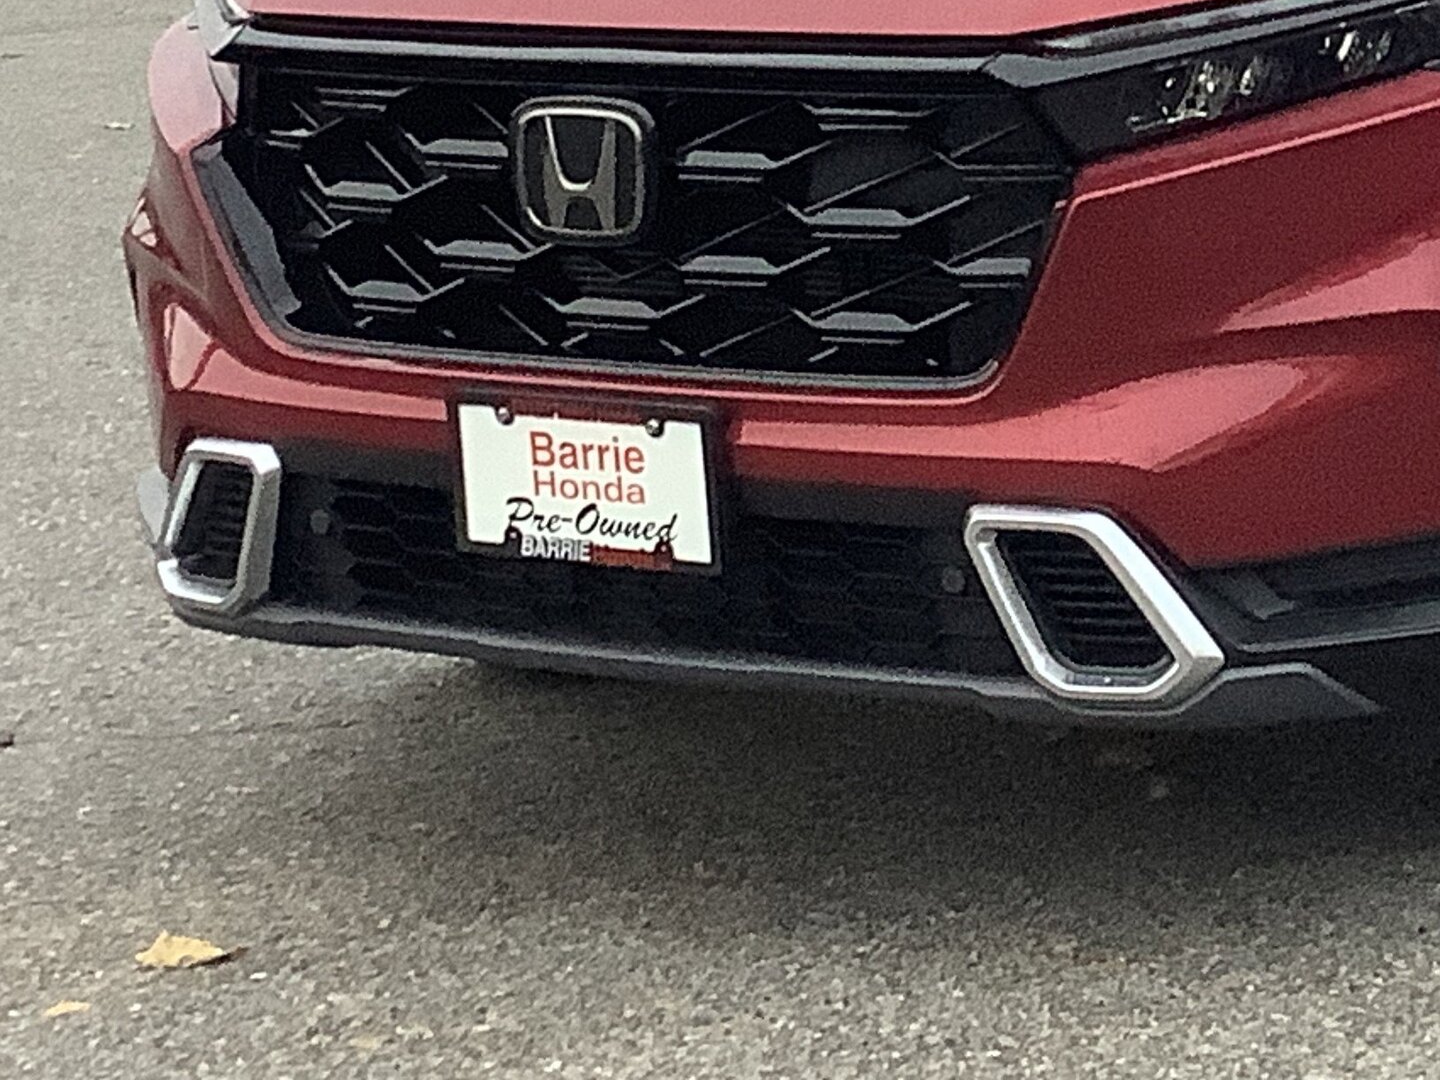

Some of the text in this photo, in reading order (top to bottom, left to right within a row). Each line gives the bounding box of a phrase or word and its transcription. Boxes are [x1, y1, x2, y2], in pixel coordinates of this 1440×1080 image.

[528, 430, 646, 474] Barrie
[532, 469, 646, 505] Honda
[505, 496, 679, 542] Pre-Owned
[519, 533, 593, 563] BARRIE
